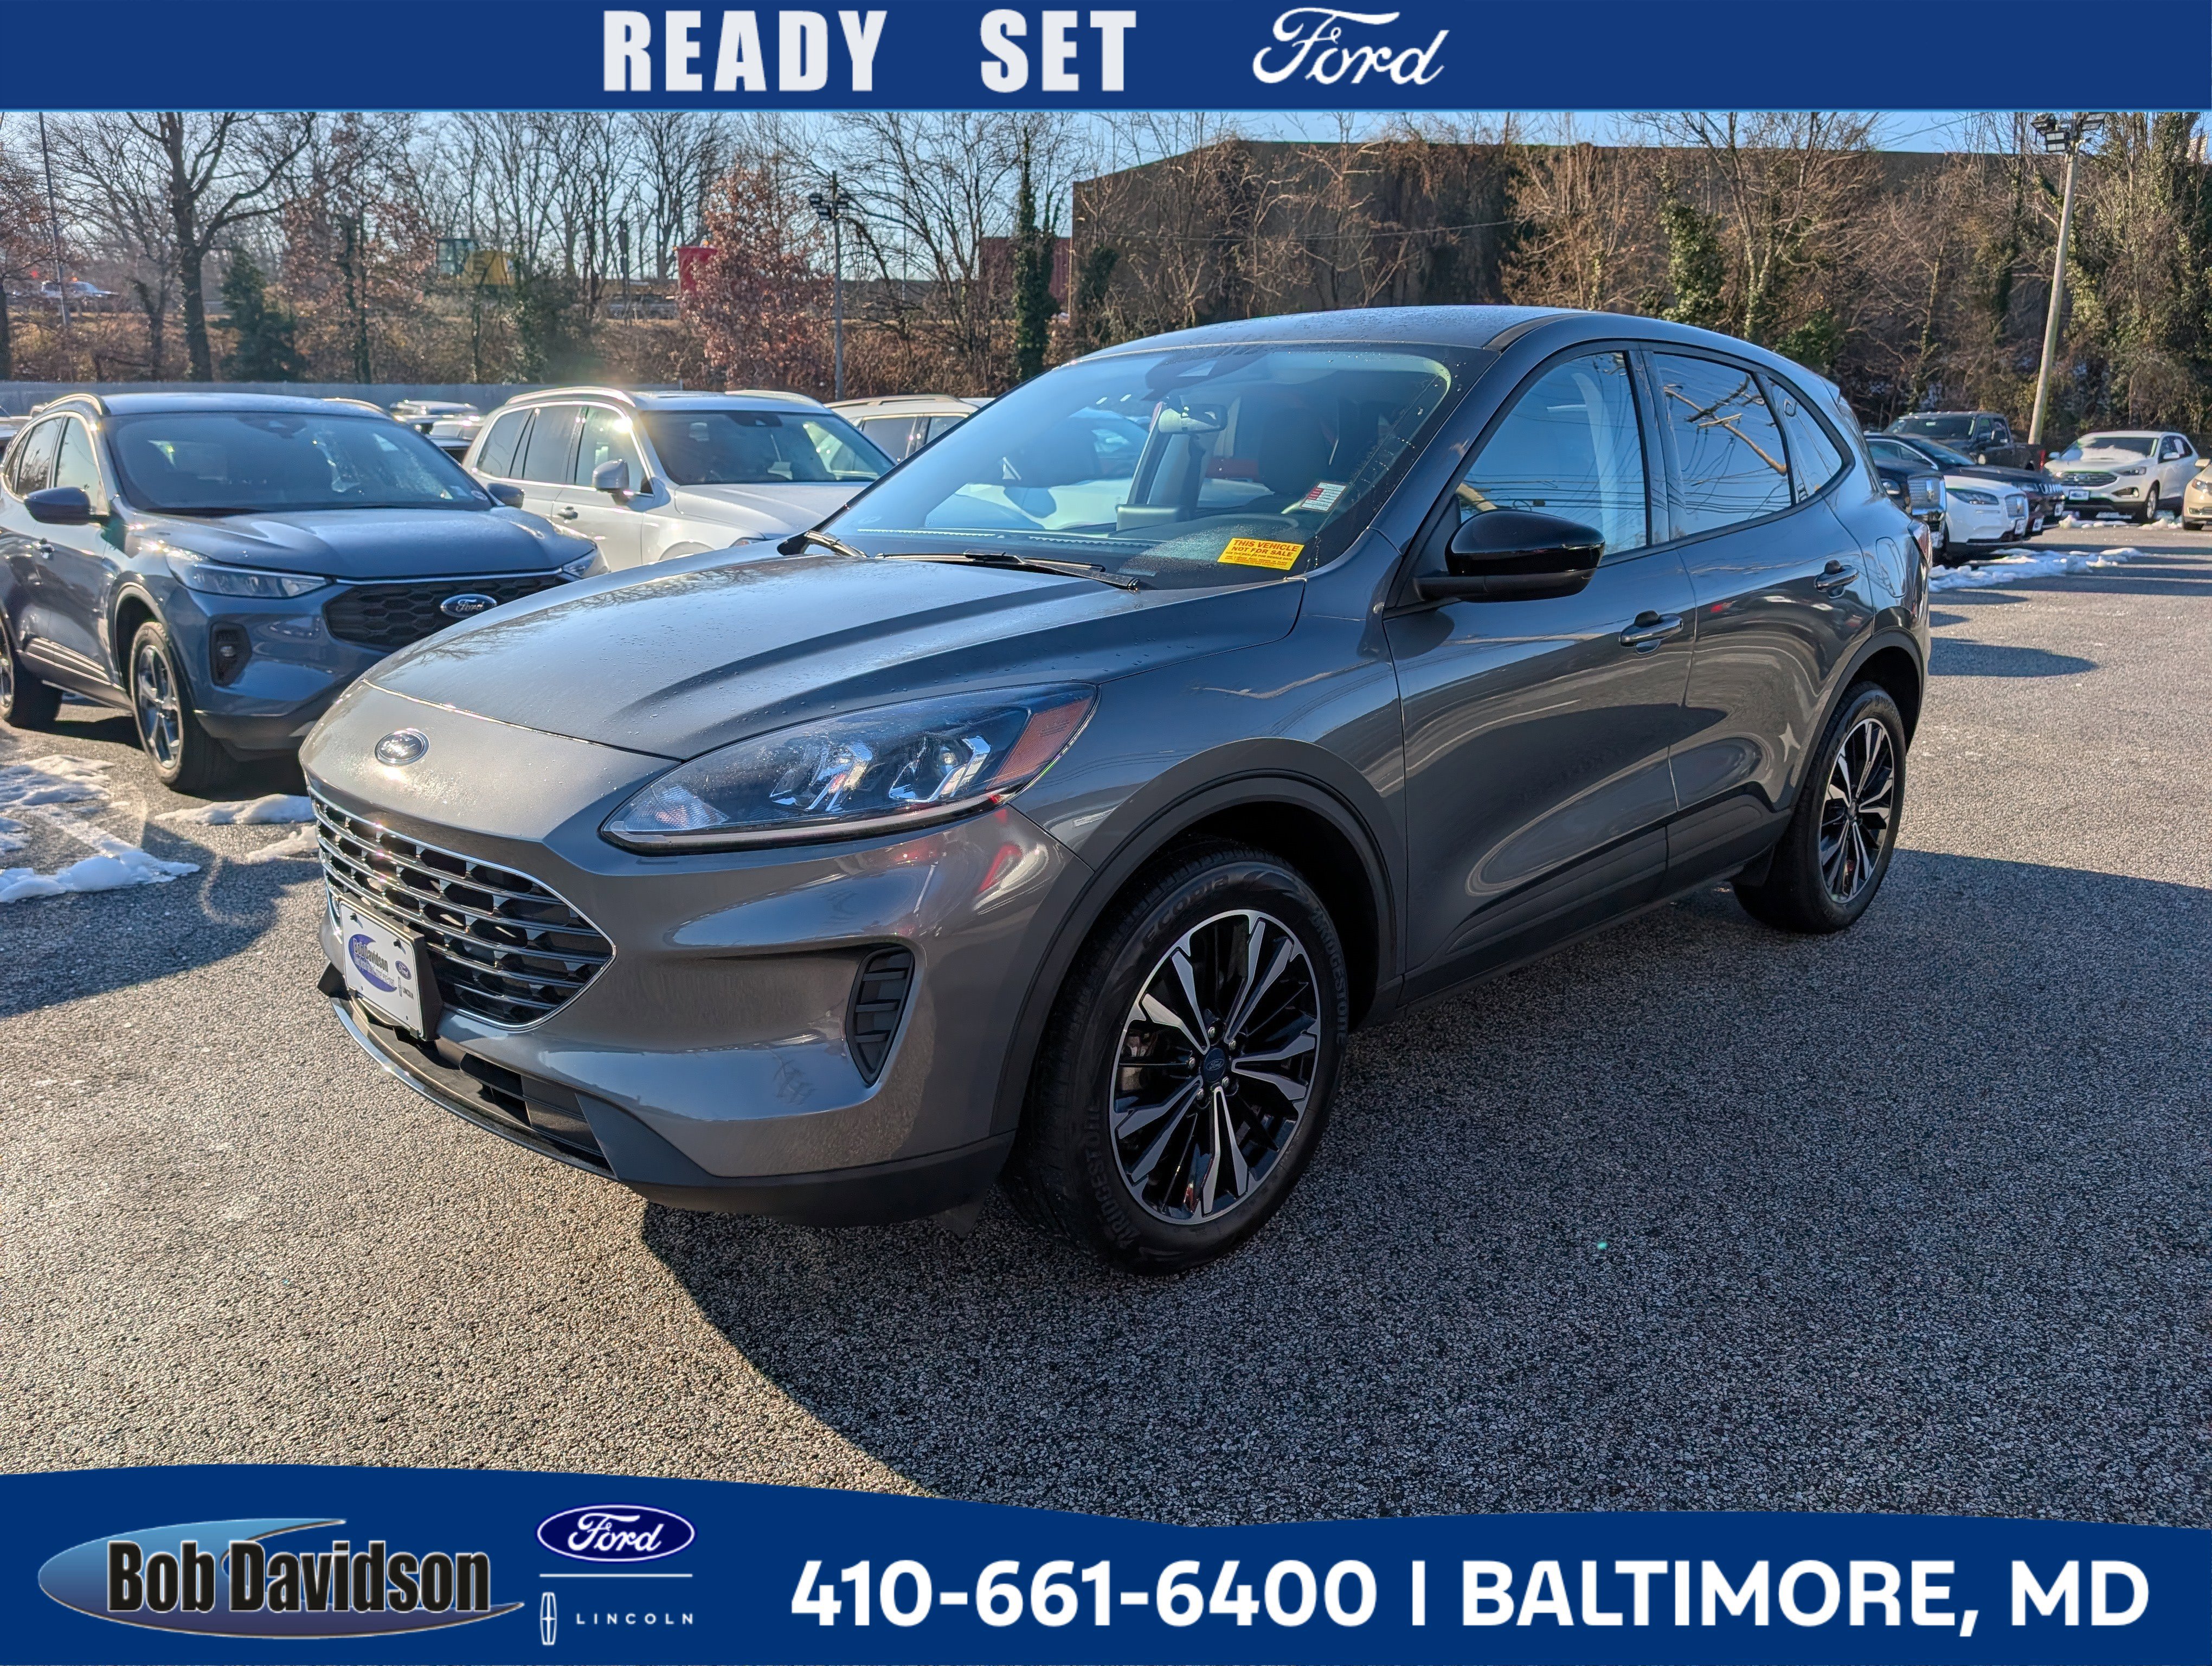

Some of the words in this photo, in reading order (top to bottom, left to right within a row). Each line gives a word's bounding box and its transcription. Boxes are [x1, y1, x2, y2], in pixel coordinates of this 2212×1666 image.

[1257, 542, 1300, 552] VEHICLE
[455, 599, 485, 613] Ford
[364, 944, 389, 974] Davidson
[398, 963, 409, 977] Ford
[1208, 1060, 1223, 1070] Ford
